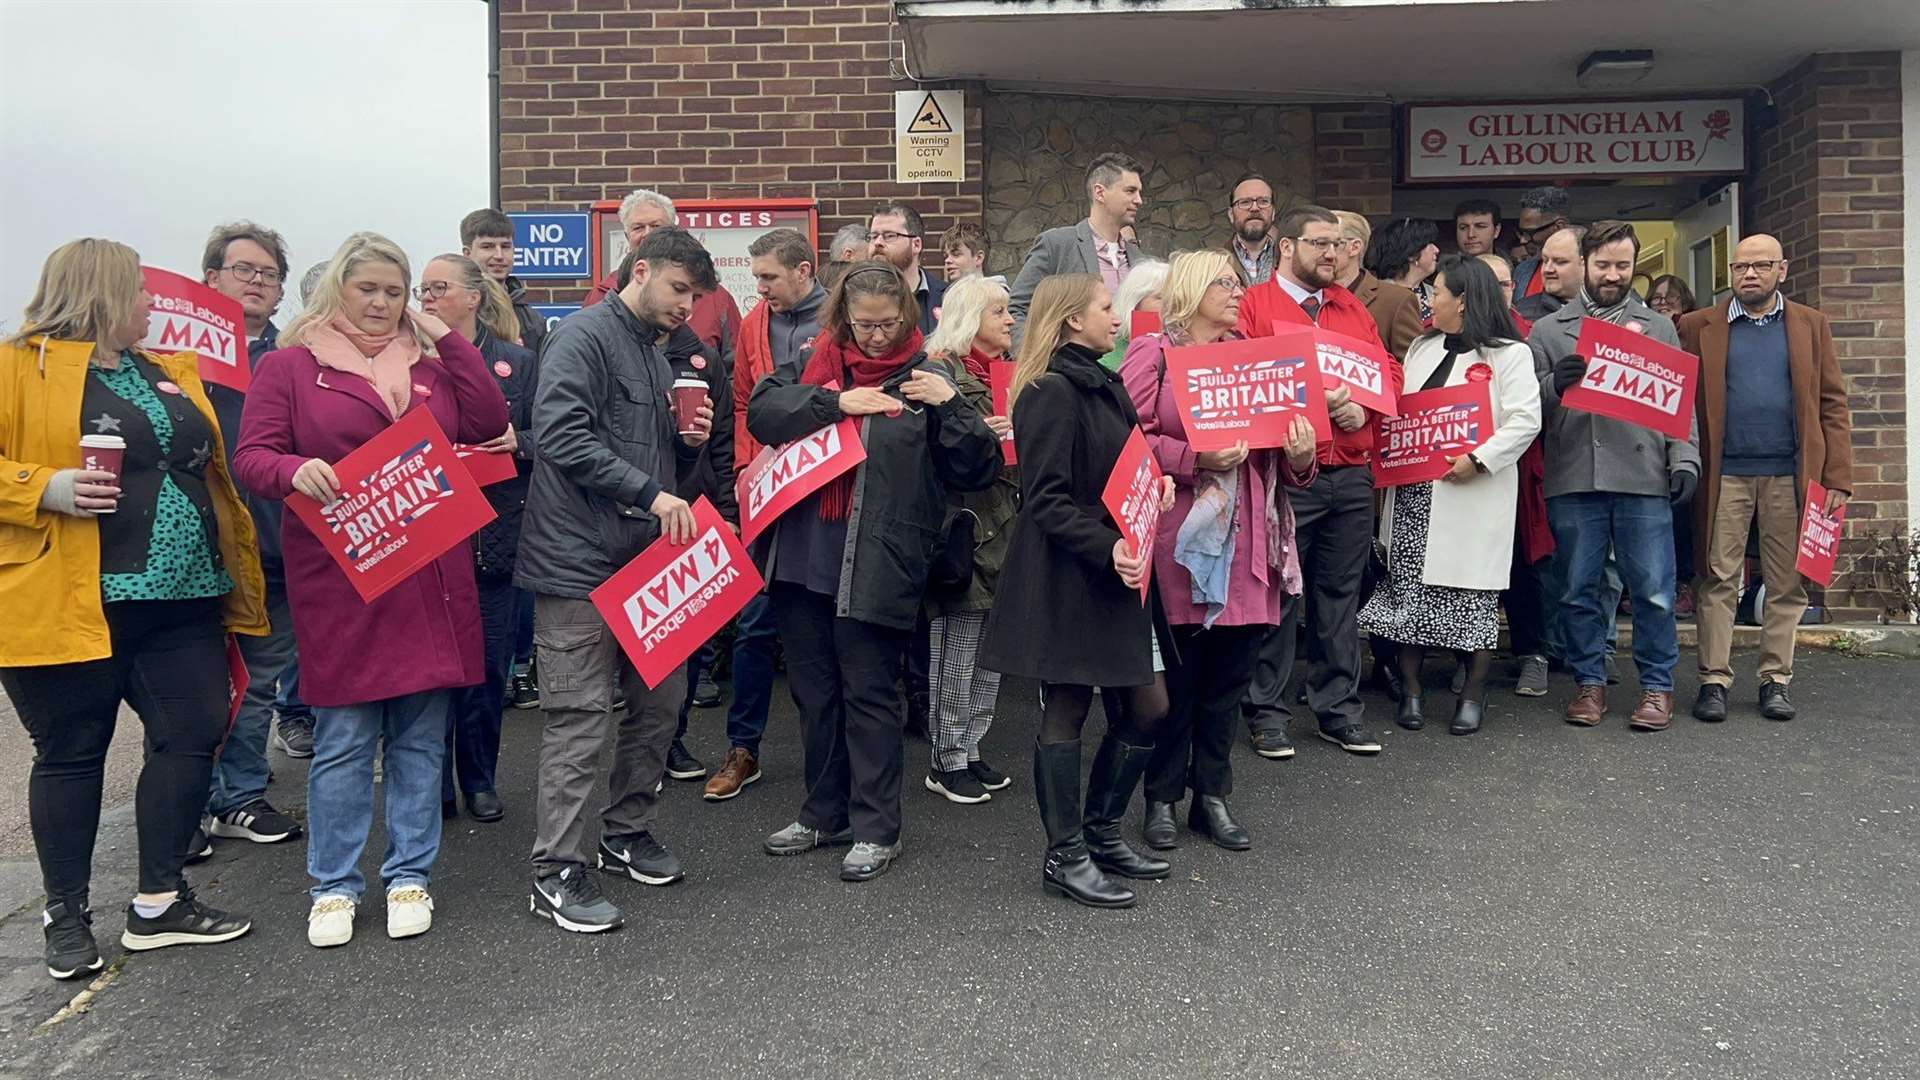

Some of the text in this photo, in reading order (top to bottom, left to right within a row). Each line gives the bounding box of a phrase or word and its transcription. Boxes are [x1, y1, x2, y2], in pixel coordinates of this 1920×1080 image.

[1468, 110, 1684, 138] GILLINGHAM
[910, 136, 950, 145] Warning
[916, 148, 944, 157] CCTV
[1457, 139, 1697, 167] LABOUR CLUB
[907, 169, 953, 179] operation
[925, 159, 935, 167] in
[529, 223, 564, 243] NO
[675, 212, 773, 228] TICES
[513, 247, 584, 266] ENTRY
[153, 293, 236, 333] te Labour
[160, 316, 232, 358] MAY
[1199, 366, 1294, 388] BUILD A BETTER
[1323, 355, 1378, 388] MAY
[1594, 342, 1686, 385] Vote Labour
[1200, 380, 1295, 410] BRITAIN
[1587, 364, 1678, 408] 4 MAY
[1194, 419, 1251, 430] Vote Labour
[1391, 410, 1469, 432] BUILD A BETTER
[1390, 421, 1469, 450] BRITAIN
[752, 485, 764, 511] 4
[771, 428, 833, 493] MAY
[1380, 460, 1399, 469] Vote
[335, 454, 426, 522] BUILD A BETTER
[343, 469, 439, 546] BRITAIN
[355, 552, 377, 573] Vote
[636, 538, 720, 631] 4 MAY
[643, 565, 740, 654] Vote Labour
